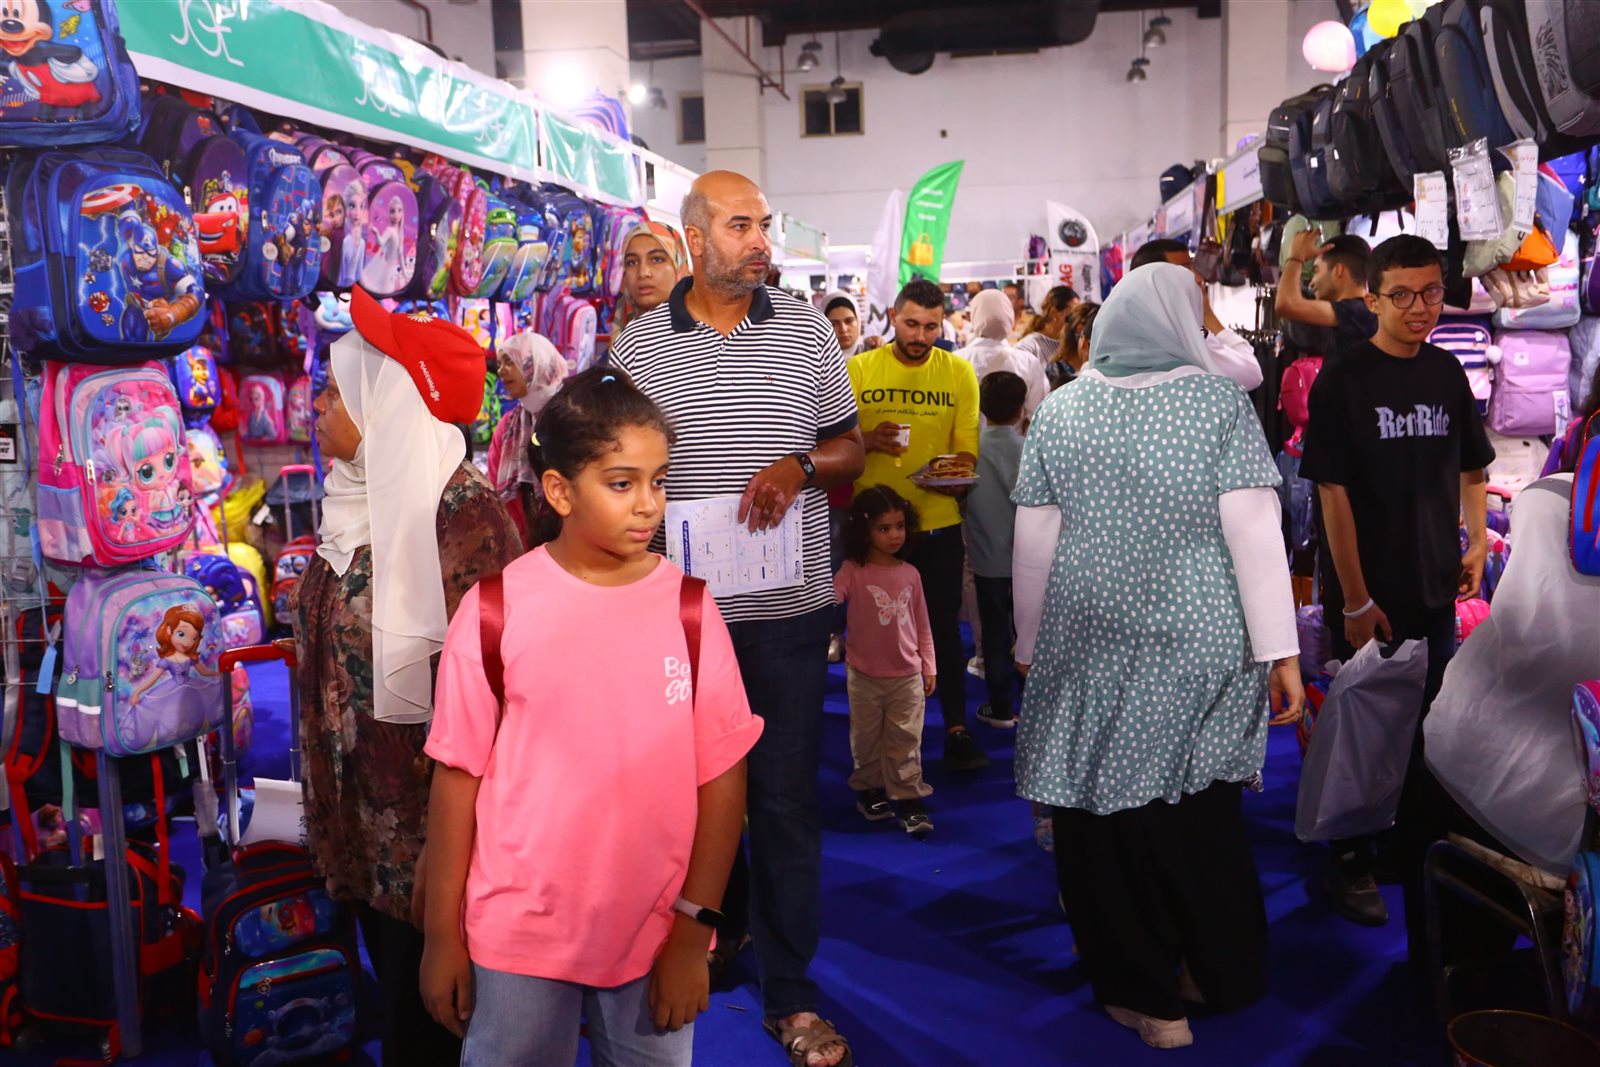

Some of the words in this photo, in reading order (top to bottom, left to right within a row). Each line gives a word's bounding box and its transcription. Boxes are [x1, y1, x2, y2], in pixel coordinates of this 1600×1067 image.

[1059, 263, 1073, 289] AG
[861, 388, 954, 407] COTTONIL
[664, 678, 693, 706] St
